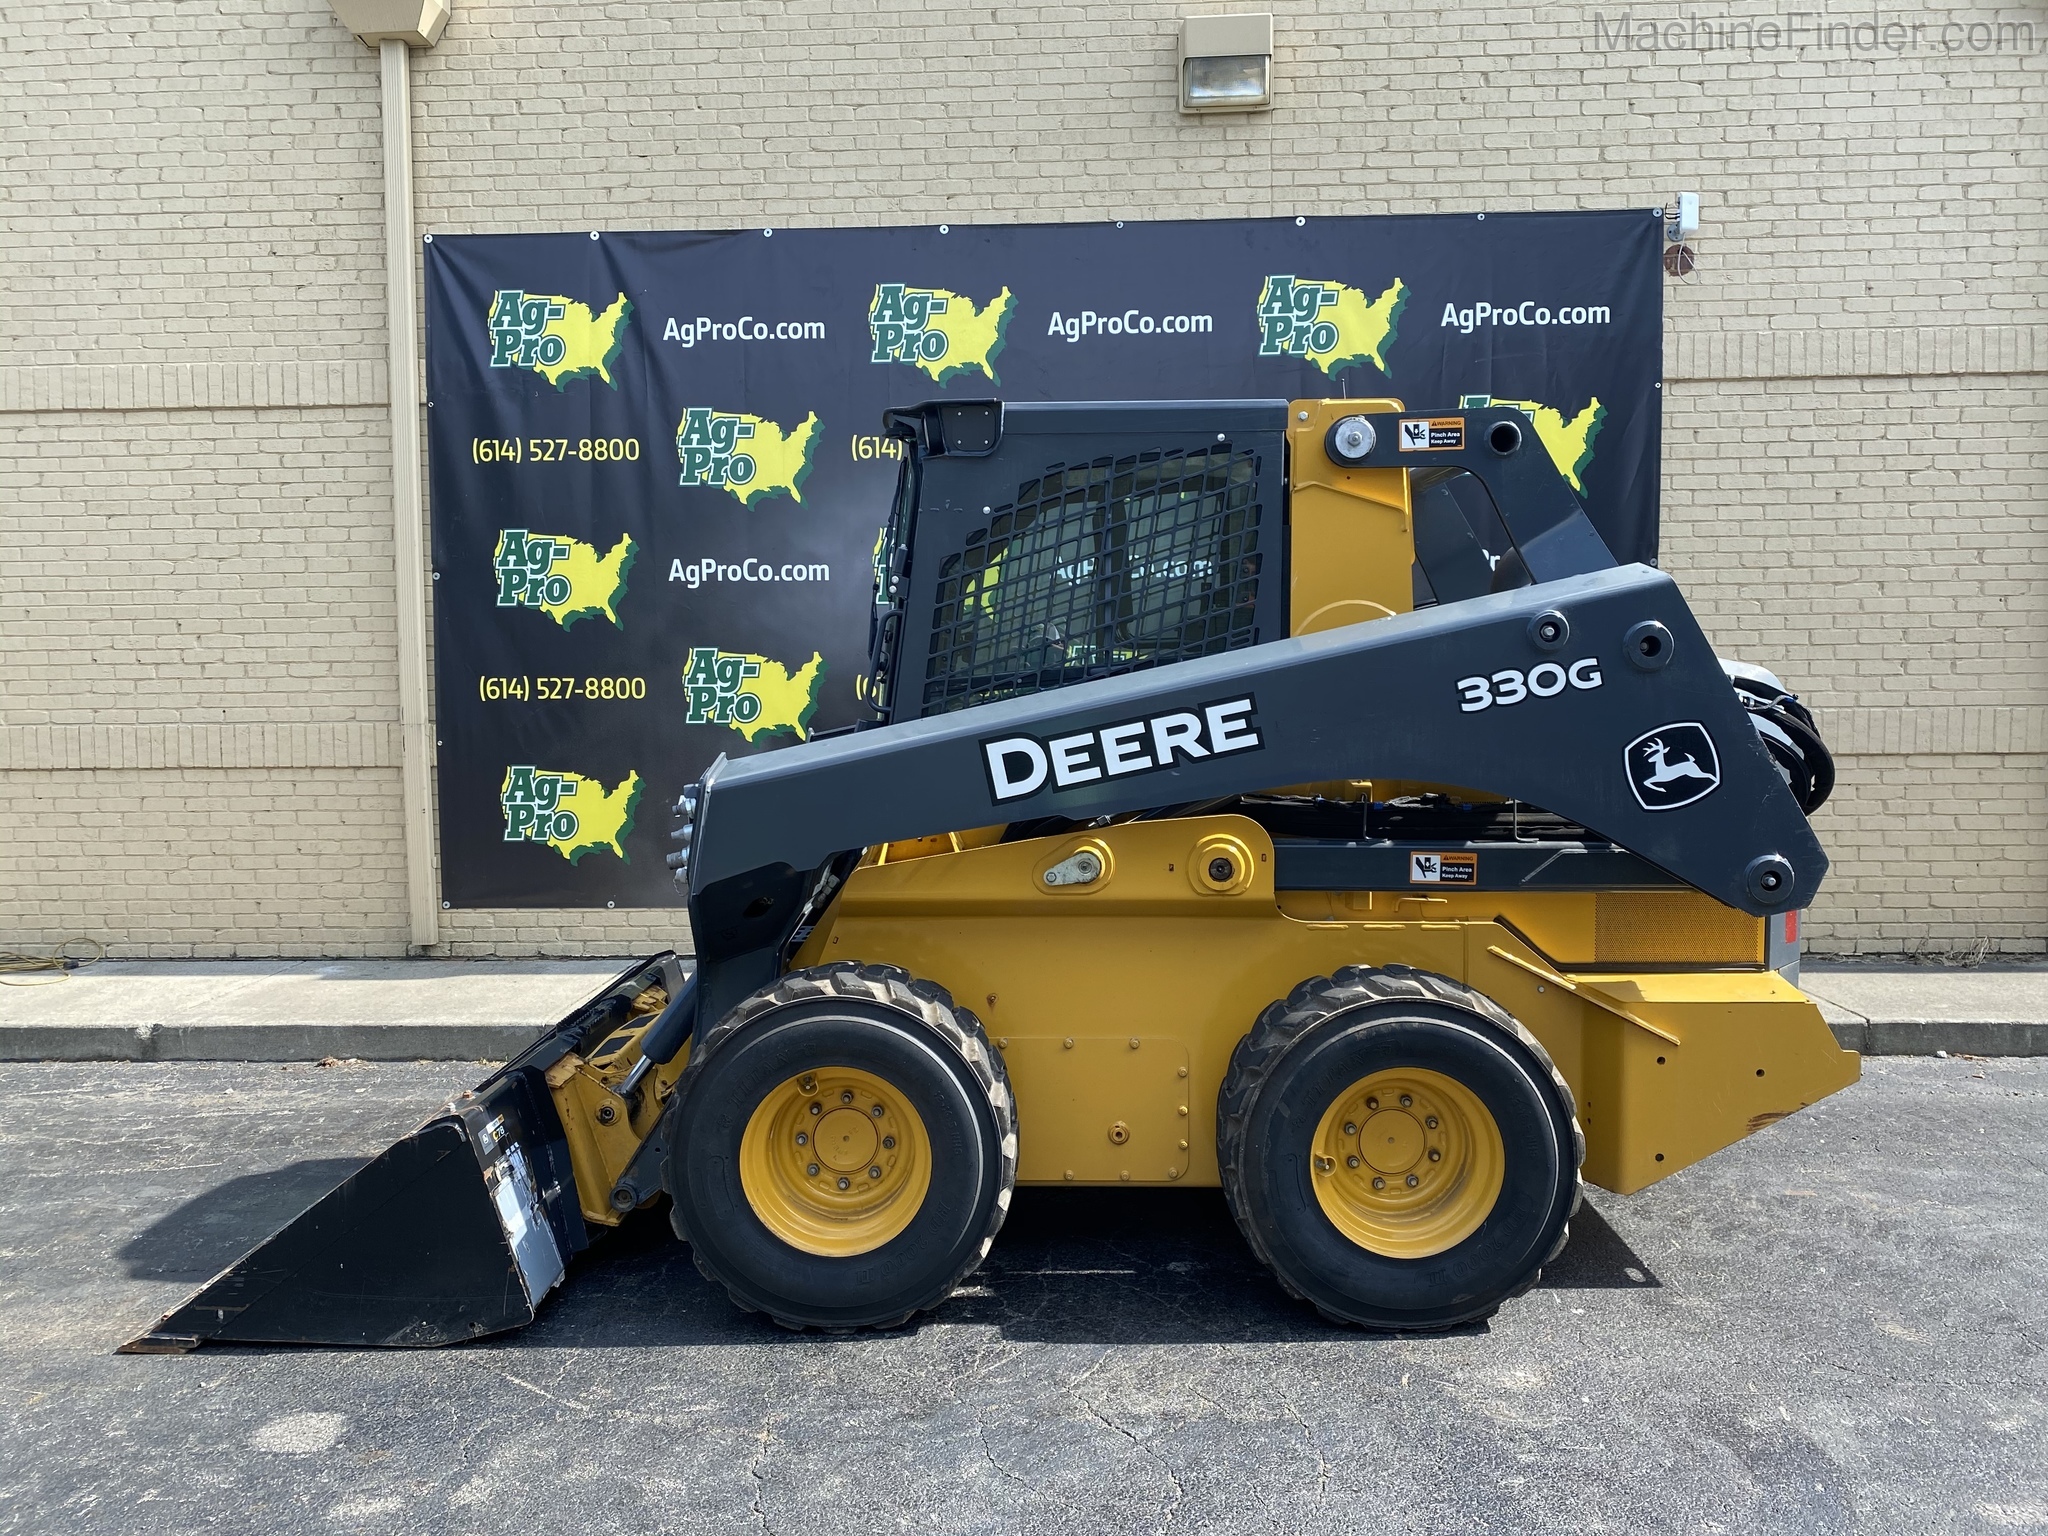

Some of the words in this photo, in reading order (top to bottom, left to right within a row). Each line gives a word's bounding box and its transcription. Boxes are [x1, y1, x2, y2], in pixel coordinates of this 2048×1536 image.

[490, 290, 565, 337] Ag-
[871, 284, 947, 332] Ag-
[1260, 275, 1338, 323] Ag-
[1441, 301, 1611, 334] AgProCo.com
[662, 317, 826, 348] AgProCo.com
[872, 323, 948, 362] Pro
[1047, 309, 1213, 343] AgProCo.com
[1260, 315, 1338, 355] Pro
[490, 329, 565, 367] Pro
[472, 438, 522, 464] (614)
[529, 437, 640, 462] 527-8800
[679, 408, 754, 455] Ag-
[851, 434, 903, 461] (614)
[680, 447, 755, 485] Pro
[496, 530, 569, 577] Ag-
[497, 568, 570, 606] Pro
[668, 557, 830, 589] AgProCo.com
[479, 676, 530, 701] (614)
[537, 675, 646, 700] 527-8800
[685, 648, 759, 695] Ag-
[1457, 657, 1603, 712] 330G
[686, 686, 760, 723] Pro
[986, 699, 1259, 800] DEERE
[503, 766, 577, 812] Ag-
[504, 804, 578, 840] Pro
[728, 1048, 791, 1107] TITAN
